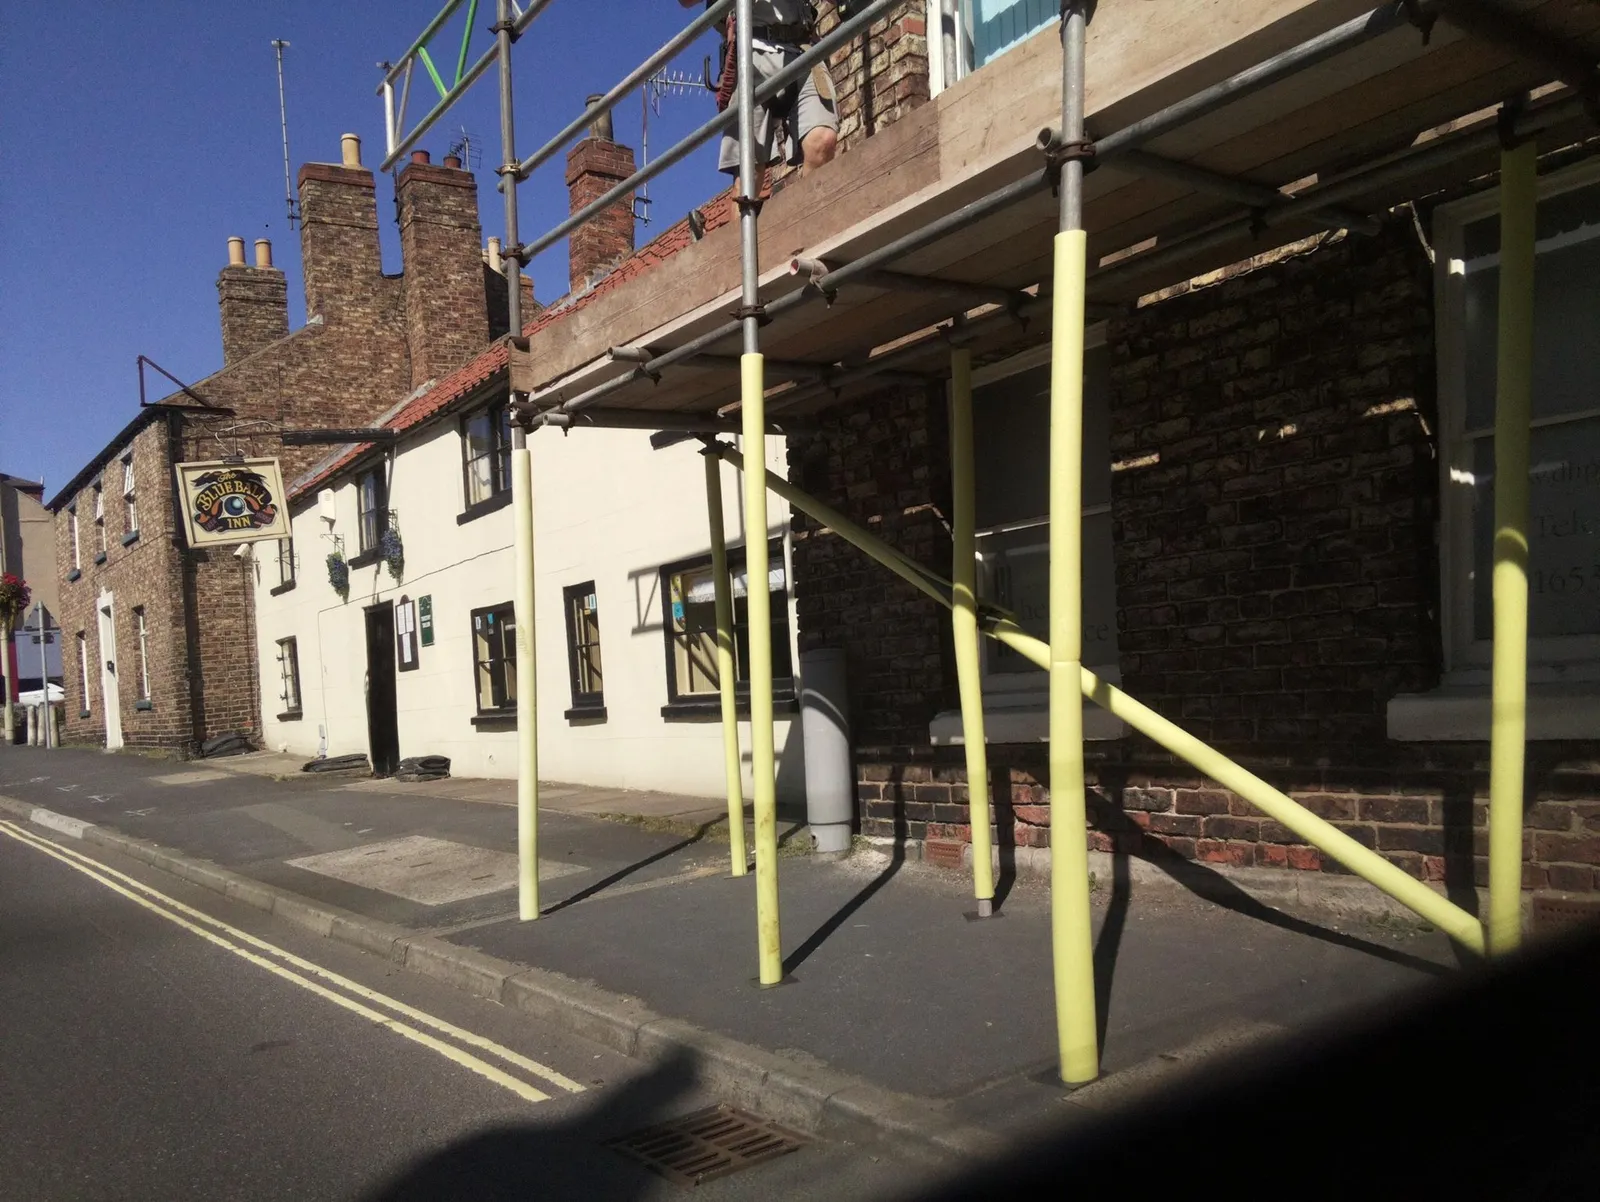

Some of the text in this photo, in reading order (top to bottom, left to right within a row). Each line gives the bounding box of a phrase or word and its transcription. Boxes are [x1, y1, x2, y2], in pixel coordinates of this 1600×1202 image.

[217, 471, 237, 483] The
[197, 480, 265, 510] BLUE BALL
[227, 516, 251, 529] INN
